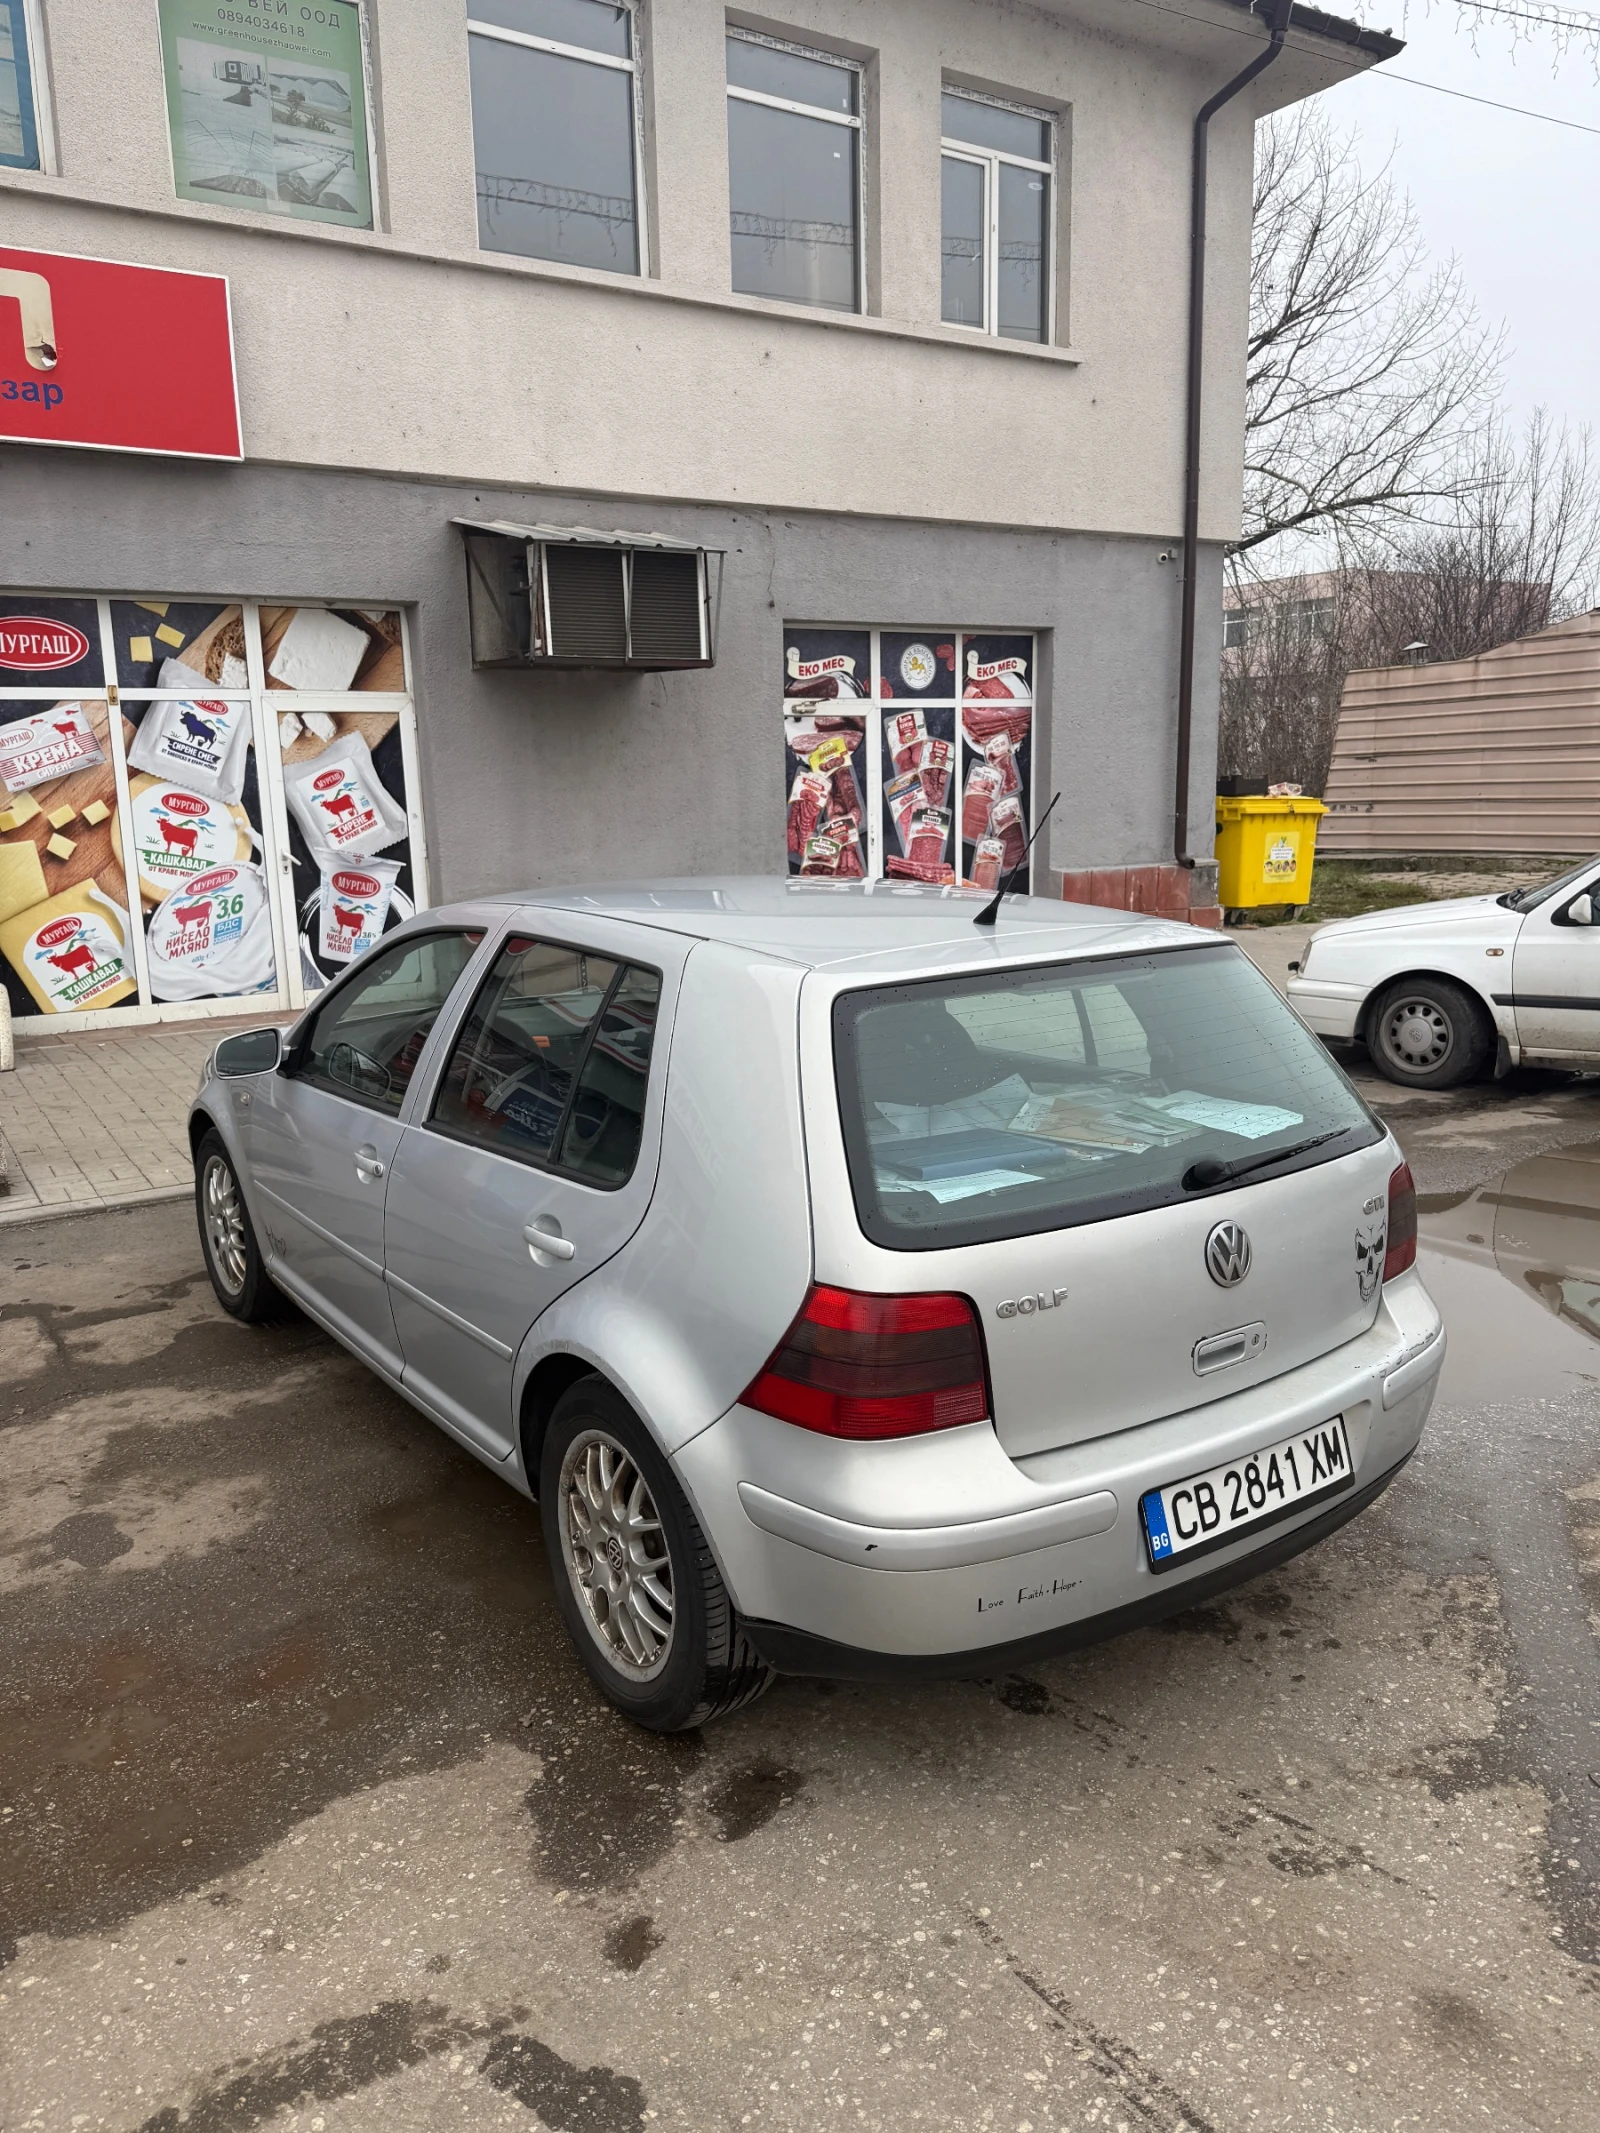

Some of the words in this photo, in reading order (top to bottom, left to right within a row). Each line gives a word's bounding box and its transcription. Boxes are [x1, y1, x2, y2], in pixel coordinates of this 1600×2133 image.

[217, 8, 305, 37] 0894034618
[300, 6, 340, 29] ООД
[192, 21, 331, 58] www.greenhousezhaowei.com
[798, 664, 819, 676] ЕКО
[822, 658, 845, 671] МЕС
[976, 665, 996, 677] ЕКО
[998, 660, 1018, 672] МЕС
[13, 740, 85, 774] КРЕМА
[172, 741, 198, 756] СИРЕНЕ
[198, 750, 216, 762] СМЕС
[37, 761, 75, 778] СИРЕНЕ
[316, 772, 342, 790] МУРГАШ
[168, 797, 204, 813] МУРГАШ
[338, 814, 369, 834] СИРЕНЕ
[150, 852, 207, 871] КАШКАВАЛ
[158, 867, 178, 875] КРАВЕ
[193, 872, 231, 893] МУРГАШ
[338, 876, 375, 892] МУРГАШ
[216, 894, 244, 919] 3,6
[42, 920, 78, 945] МУРГАШ
[217, 918, 240, 931] БДС
[67, 961, 118, 998] КАШКАВАЛ
[74, 997, 83, 1005] ОТ
[82, 986, 102, 1000] КРАВЕ
[102, 974, 121, 990] МЛЯКО
[1362, 1193, 1385, 1215] GTI
[996, 1287, 1069, 1318] GOLF
[1171, 1482, 1221, 1539] CB
[1224, 1452, 1302, 1521] 2841
[1302, 1426, 1346, 1485] XM
[1152, 1533, 1170, 1552] BG
[978, 1597, 1004, 1613] Love
[1017, 1584, 1044, 1604] Faith
[1053, 1578, 1077, 1595] Hope
